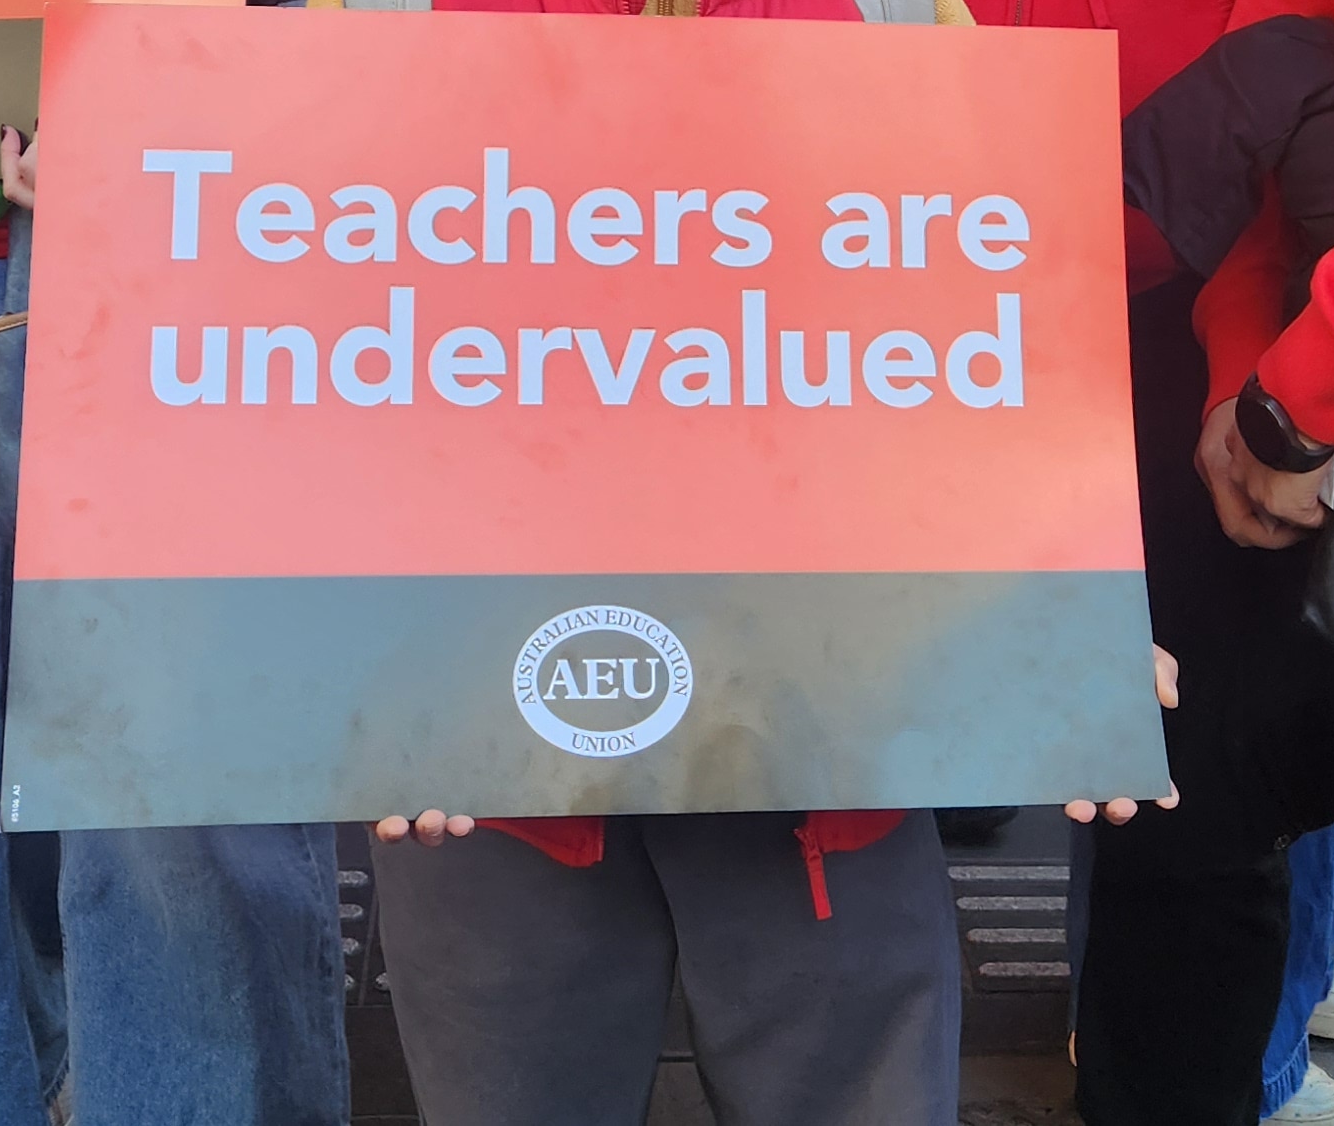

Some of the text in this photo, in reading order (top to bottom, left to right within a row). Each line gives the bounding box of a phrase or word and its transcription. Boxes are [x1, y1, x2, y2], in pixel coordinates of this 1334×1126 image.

[141, 147, 1032, 273] Teachers are
[149, 285, 1025, 409] undervalued
[517, 609, 688, 705] AUSTRALIAN EDUCATION
[542, 658, 660, 700] AEU
[571, 732, 636, 753] UNION
